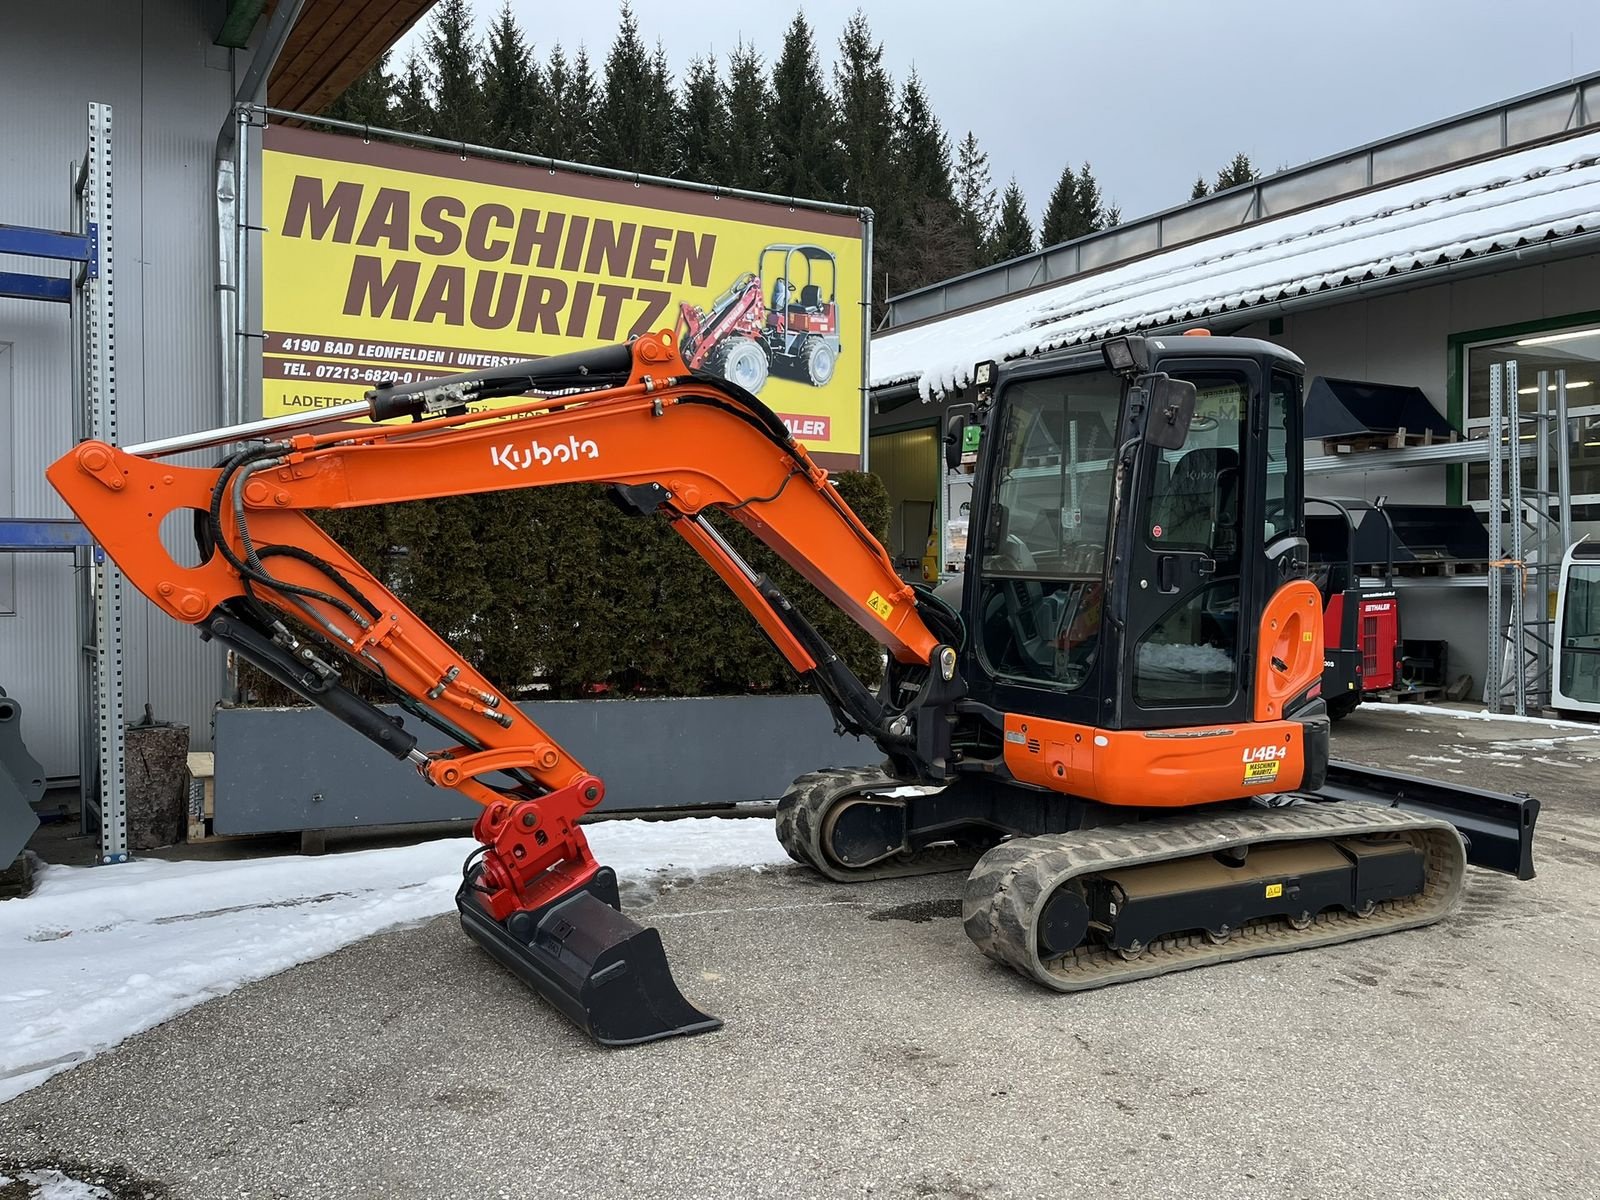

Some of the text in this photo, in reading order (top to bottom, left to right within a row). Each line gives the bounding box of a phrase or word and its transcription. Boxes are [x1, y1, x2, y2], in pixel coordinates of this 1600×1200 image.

[281, 174, 717, 288] MASCHINEN
[342, 254, 672, 342] MAURITZ
[282, 338, 320, 352] 4190
[324, 341, 354, 356] BAD
[358, 344, 445, 363] LEONFELDEN
[283, 362, 311, 377] TEL.
[315, 365, 412, 383] 07213-6820-0
[490, 435, 599, 471] Kubota
[1242, 745, 1287, 762] U48-4
